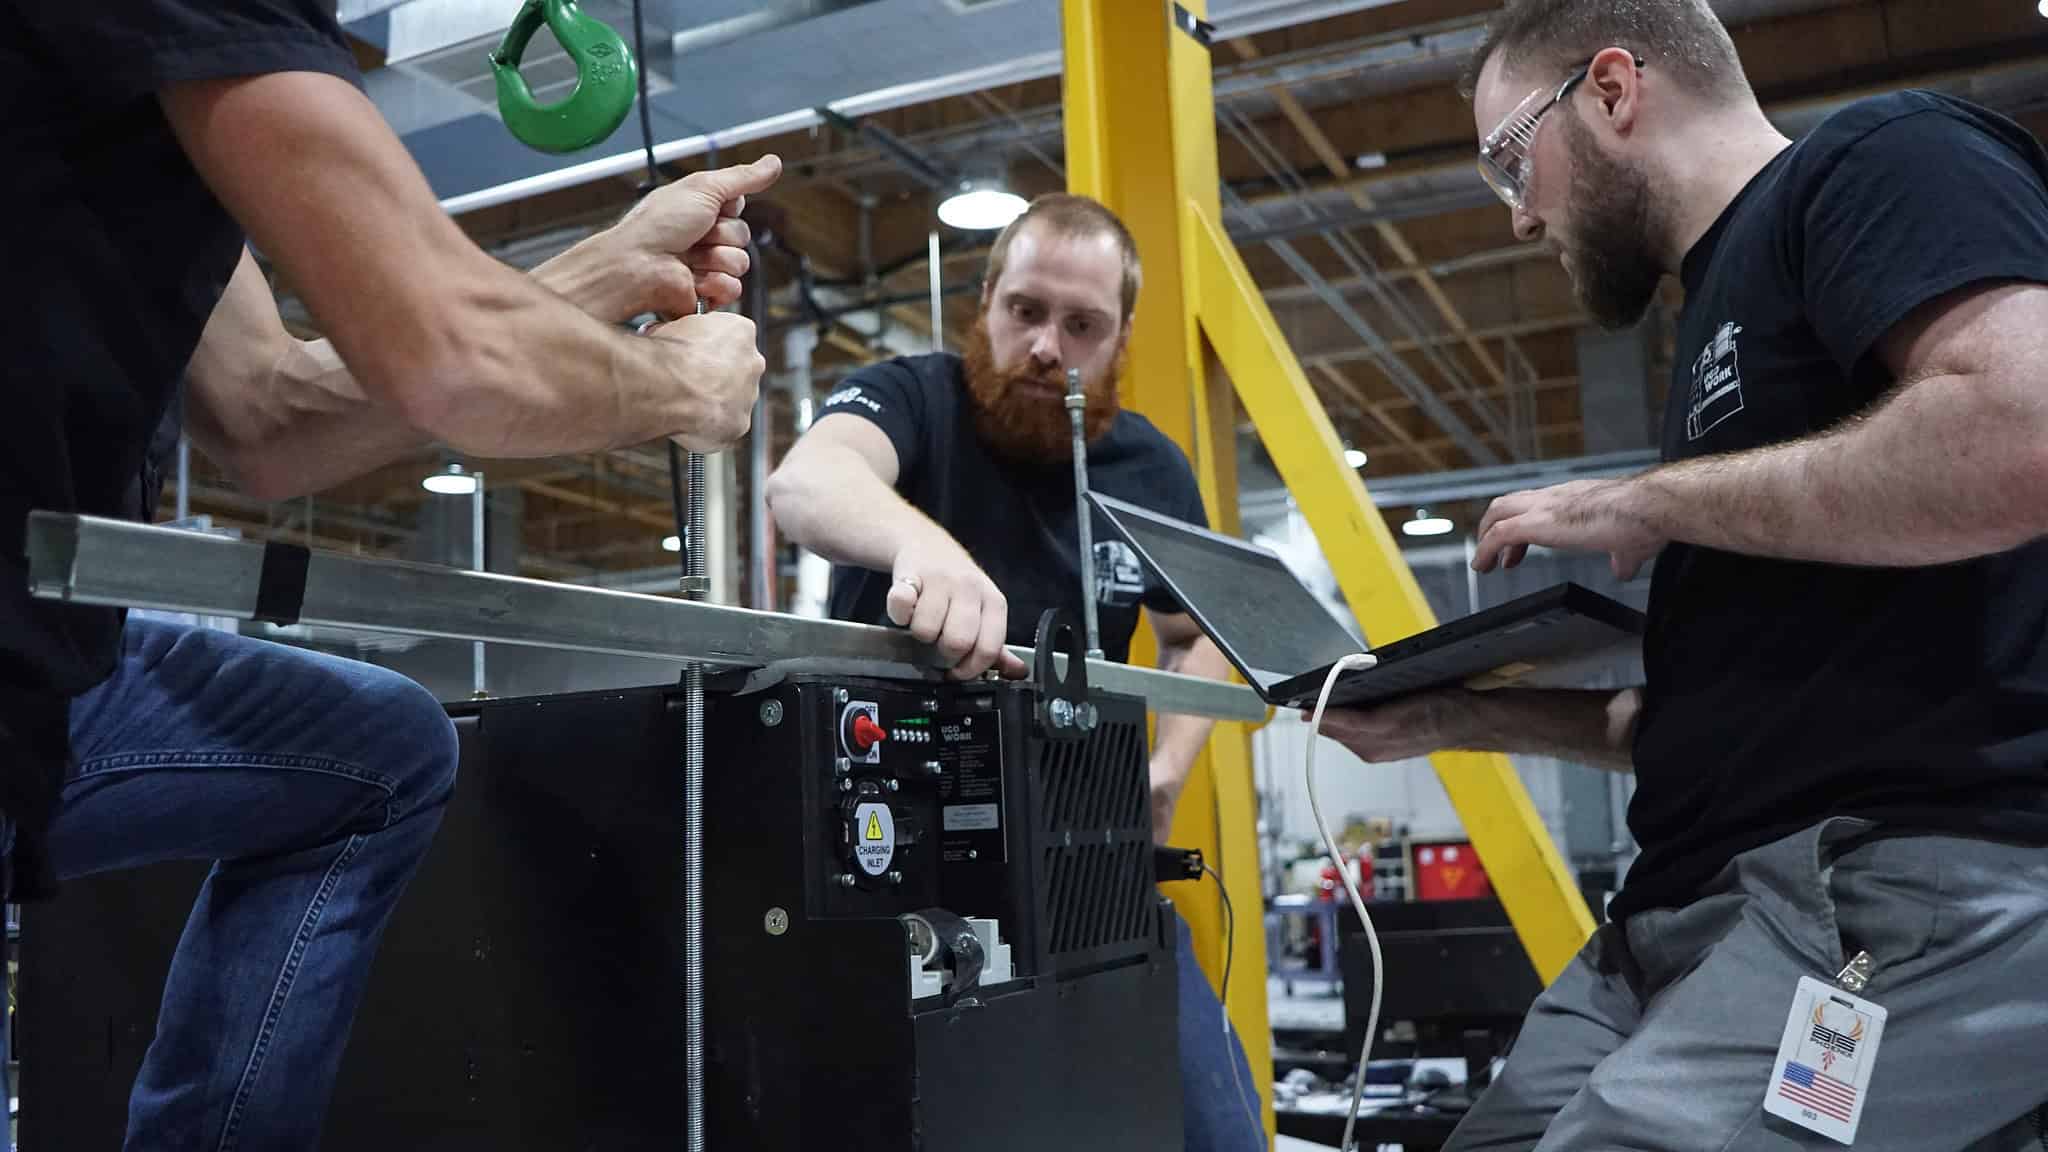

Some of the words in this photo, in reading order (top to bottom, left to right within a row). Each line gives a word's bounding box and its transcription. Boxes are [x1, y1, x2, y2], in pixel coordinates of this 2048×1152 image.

[1705, 365, 1733, 392] WORK
[944, 732, 972, 741] WORK
[859, 846, 890, 856] CHARGING
[867, 859, 883, 867] INLET
[1809, 1036, 1853, 1059] PHOENIX
